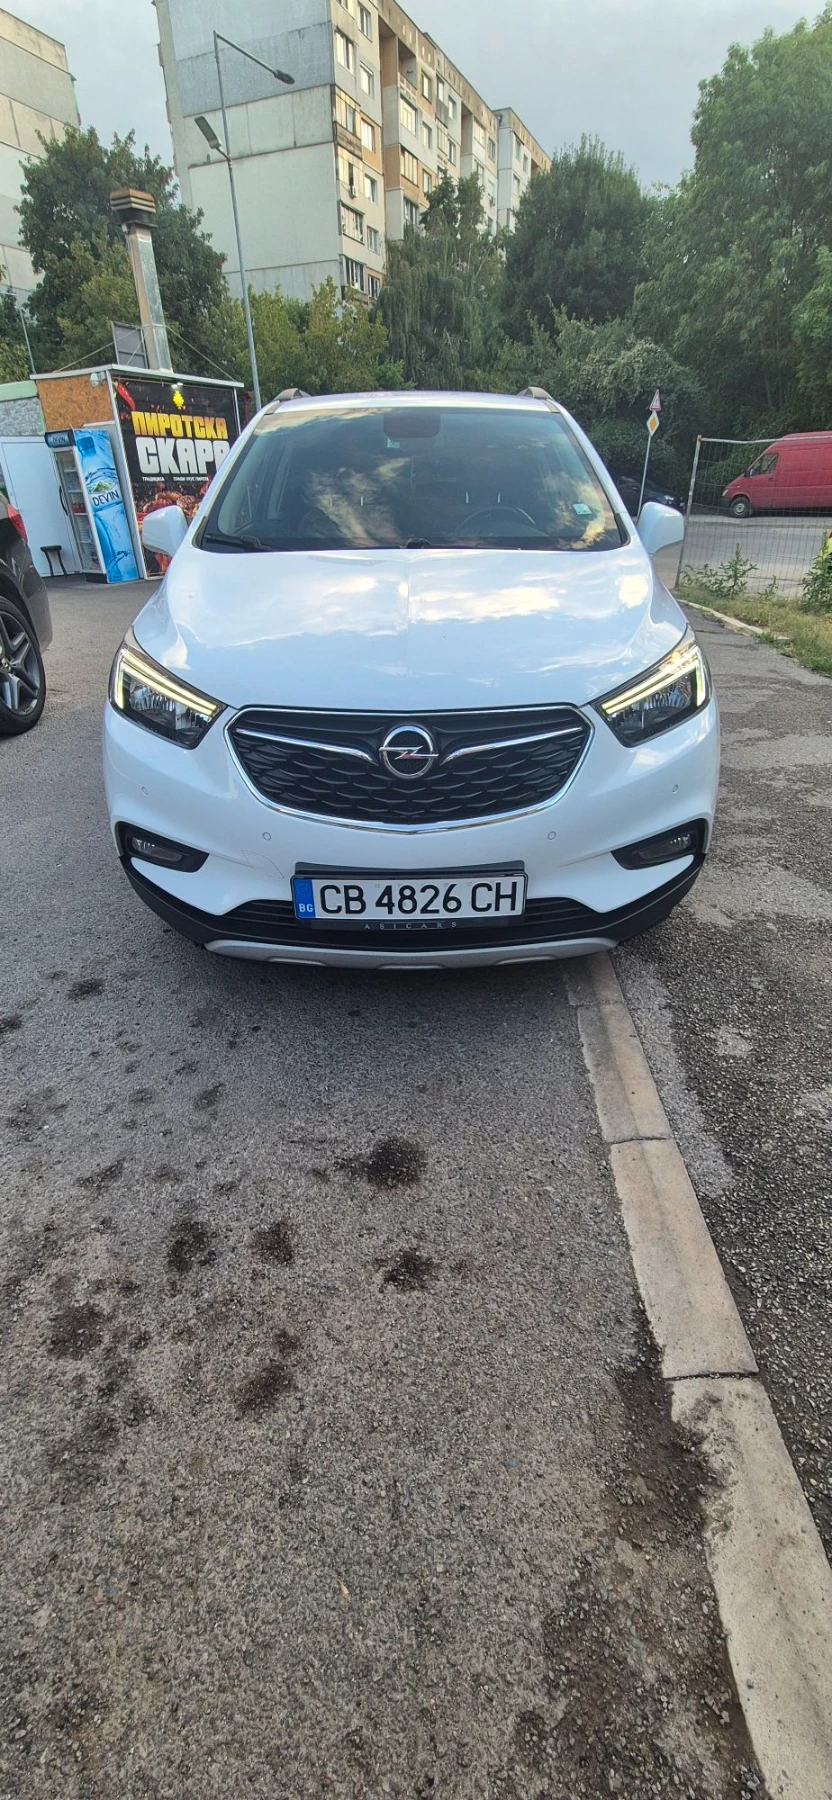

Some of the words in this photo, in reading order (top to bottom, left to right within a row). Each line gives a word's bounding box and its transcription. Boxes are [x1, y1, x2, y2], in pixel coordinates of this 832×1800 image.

[131, 411, 228, 439] ПИРОТСКА
[92, 490, 120, 506] DEVIN
[299, 903, 313, 913] BG
[319, 885, 367, 915] CB
[375, 883, 462, 915] 4826
[471, 881, 518, 912] CH
